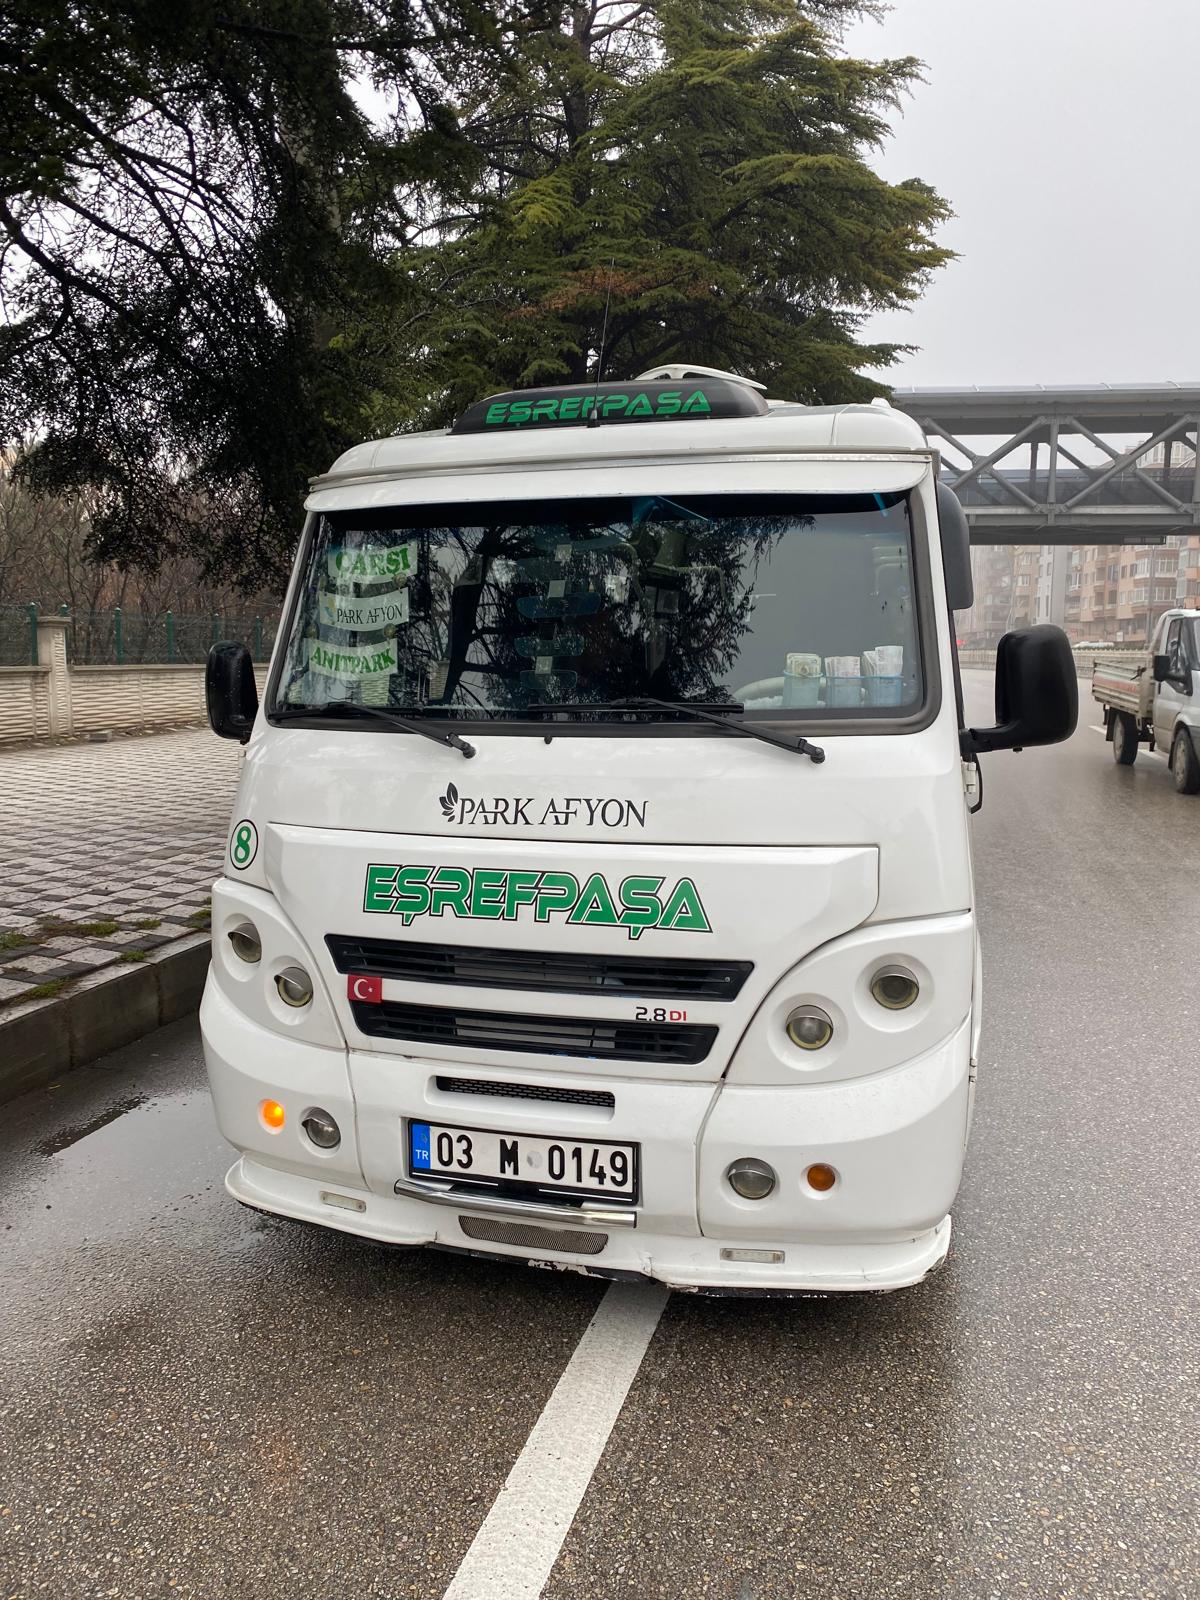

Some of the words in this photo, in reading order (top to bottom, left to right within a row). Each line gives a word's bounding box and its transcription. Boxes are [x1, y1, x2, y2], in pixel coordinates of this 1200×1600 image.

[337, 608, 363, 624] PARK
[366, 603, 403, 624] AFYON
[457, 797, 535, 825] PARK
[539, 797, 649, 828] AFYON
[234, 825, 252, 864] 8
[363, 863, 713, 940] EŞREFPAŞA
[415, 1149, 429, 1161] TR
[436, 1131, 473, 1169] 03
[499, 1138, 519, 1176] M
[547, 1144, 628, 1187] 0149
